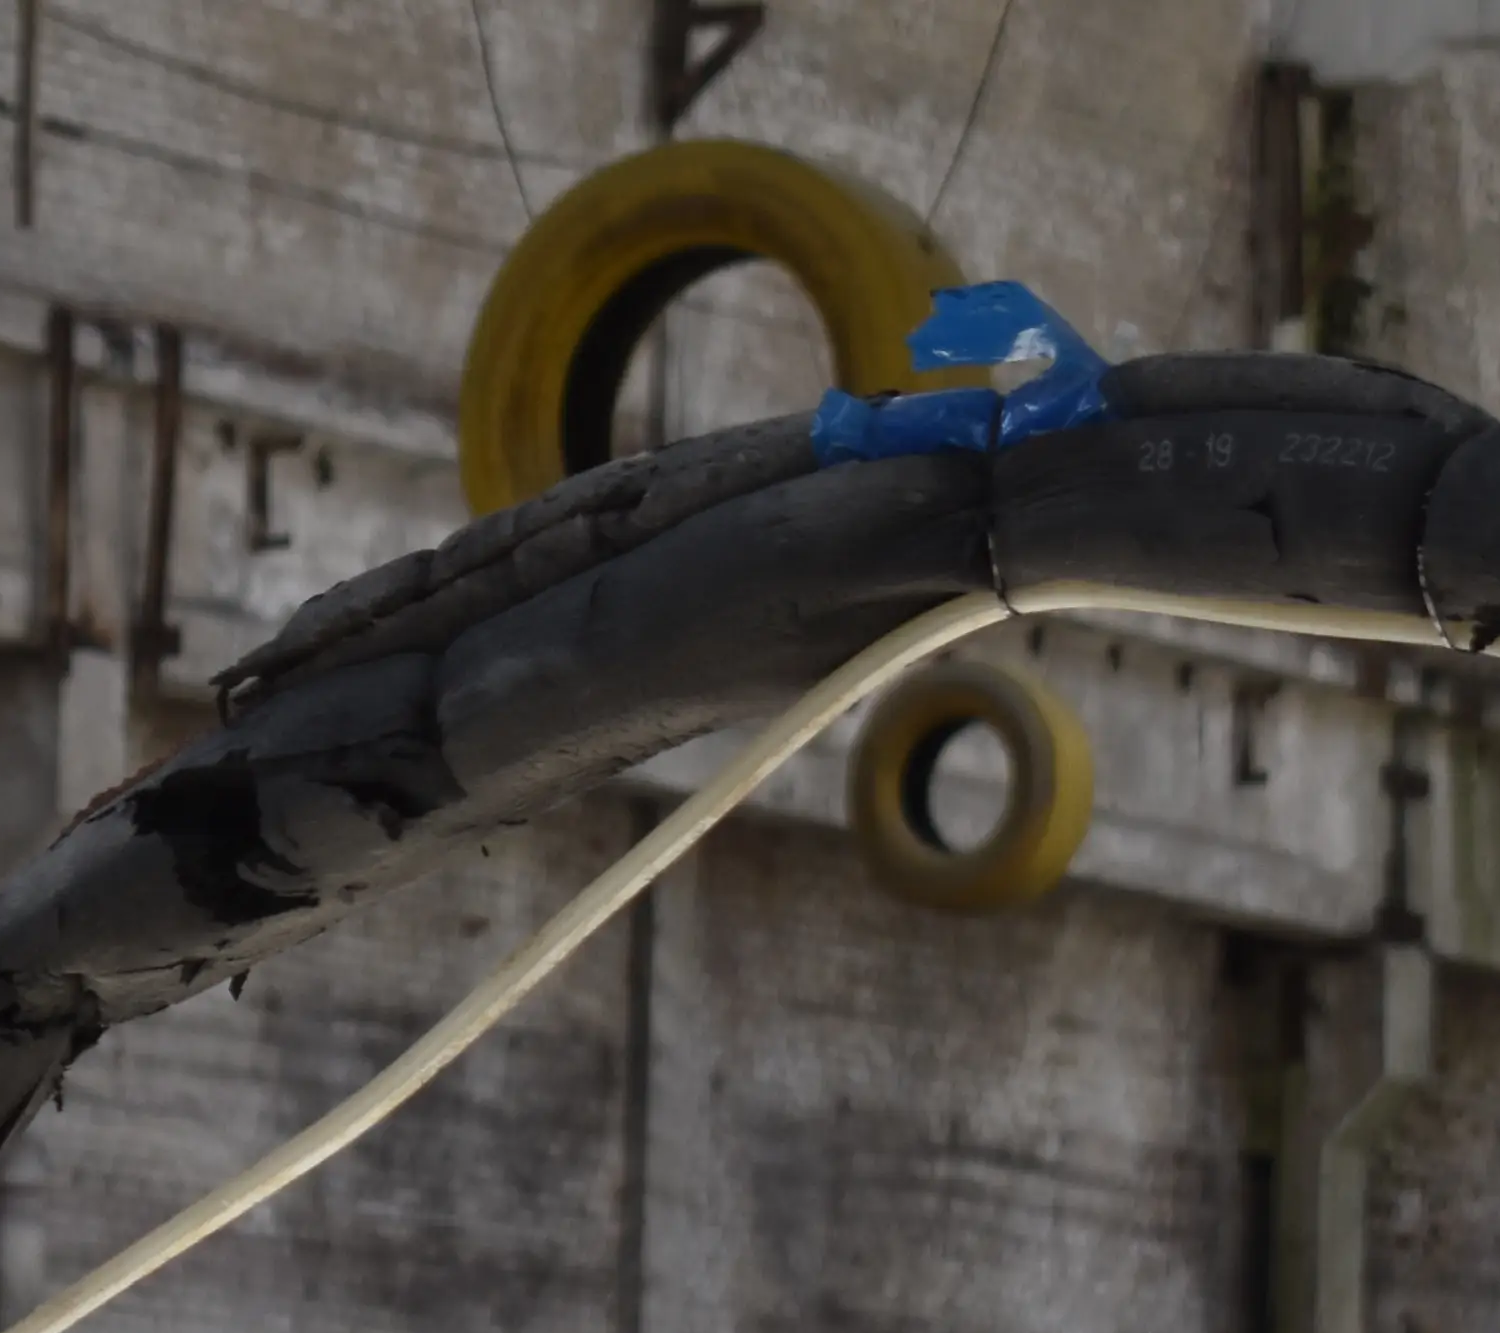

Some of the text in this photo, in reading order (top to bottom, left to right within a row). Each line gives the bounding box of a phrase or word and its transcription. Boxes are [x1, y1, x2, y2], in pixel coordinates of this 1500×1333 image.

[1138, 438, 1173, 472] 28
[1205, 431, 1235, 468] 19
[1277, 432, 1397, 472] 232212
